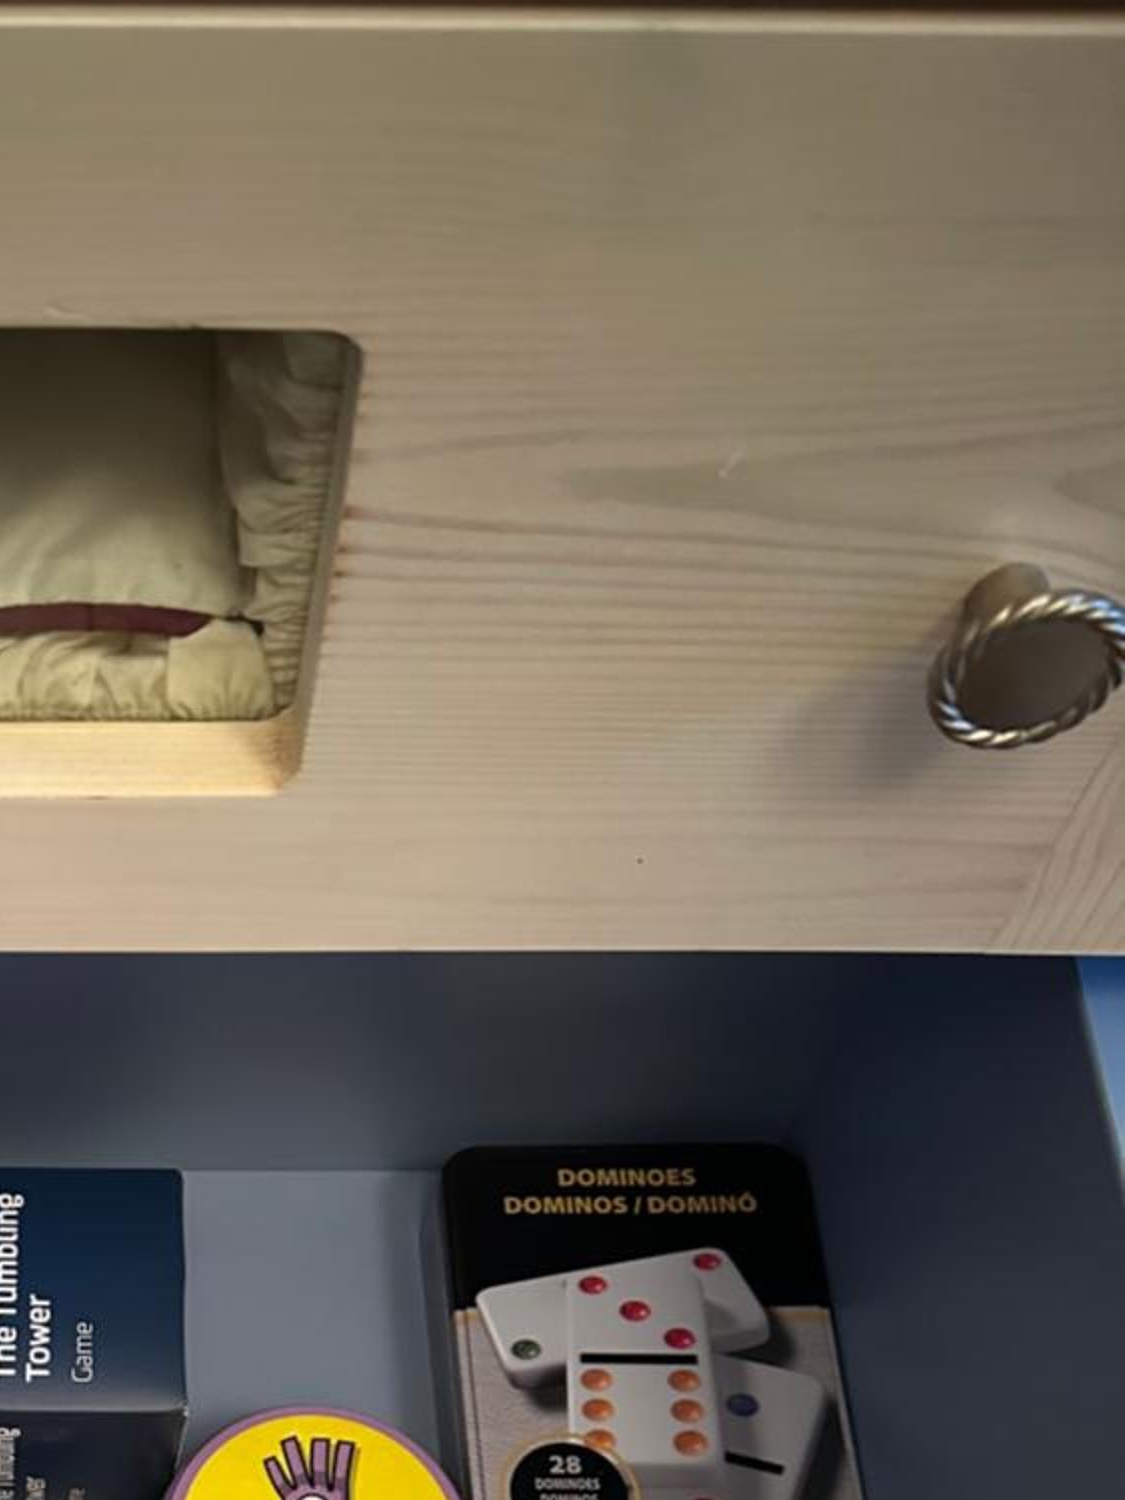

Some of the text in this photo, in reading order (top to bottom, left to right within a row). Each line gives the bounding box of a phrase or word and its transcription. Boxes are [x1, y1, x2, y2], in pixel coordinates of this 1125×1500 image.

[558, 1168, 696, 1187] DOMINOES
[504, 1196, 627, 1215] DOMINOS
[648, 1192, 758, 1214] DOMINÓ
[26, 1294, 51, 1382] Tower
[71, 1321, 93, 1383] Game
[549, 1455, 582, 1474] 28
